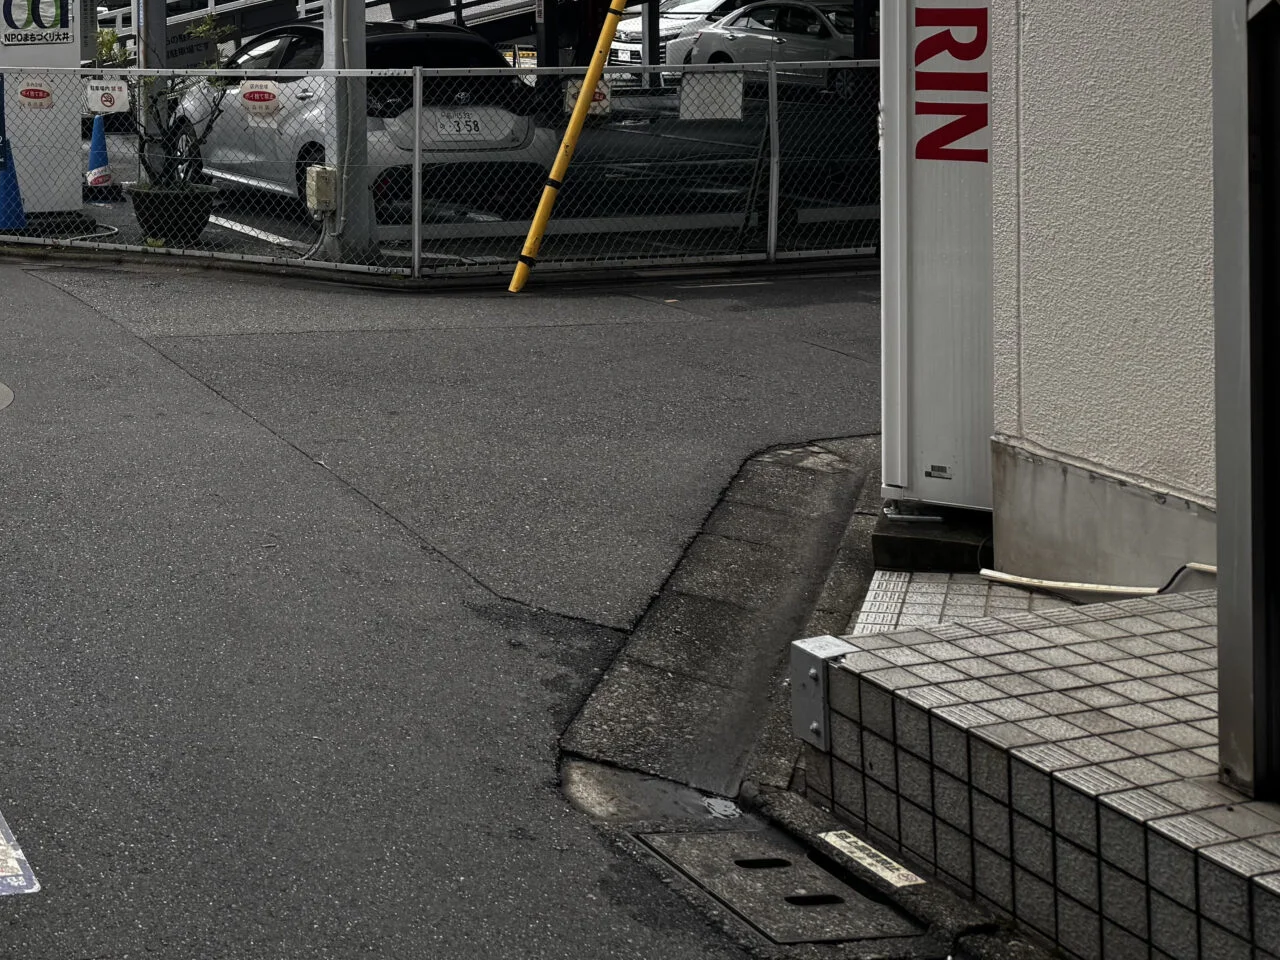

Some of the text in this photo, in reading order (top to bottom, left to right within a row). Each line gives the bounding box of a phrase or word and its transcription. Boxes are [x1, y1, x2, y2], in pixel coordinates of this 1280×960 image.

[4, 32, 70, 42] NPOまちづくり大井
